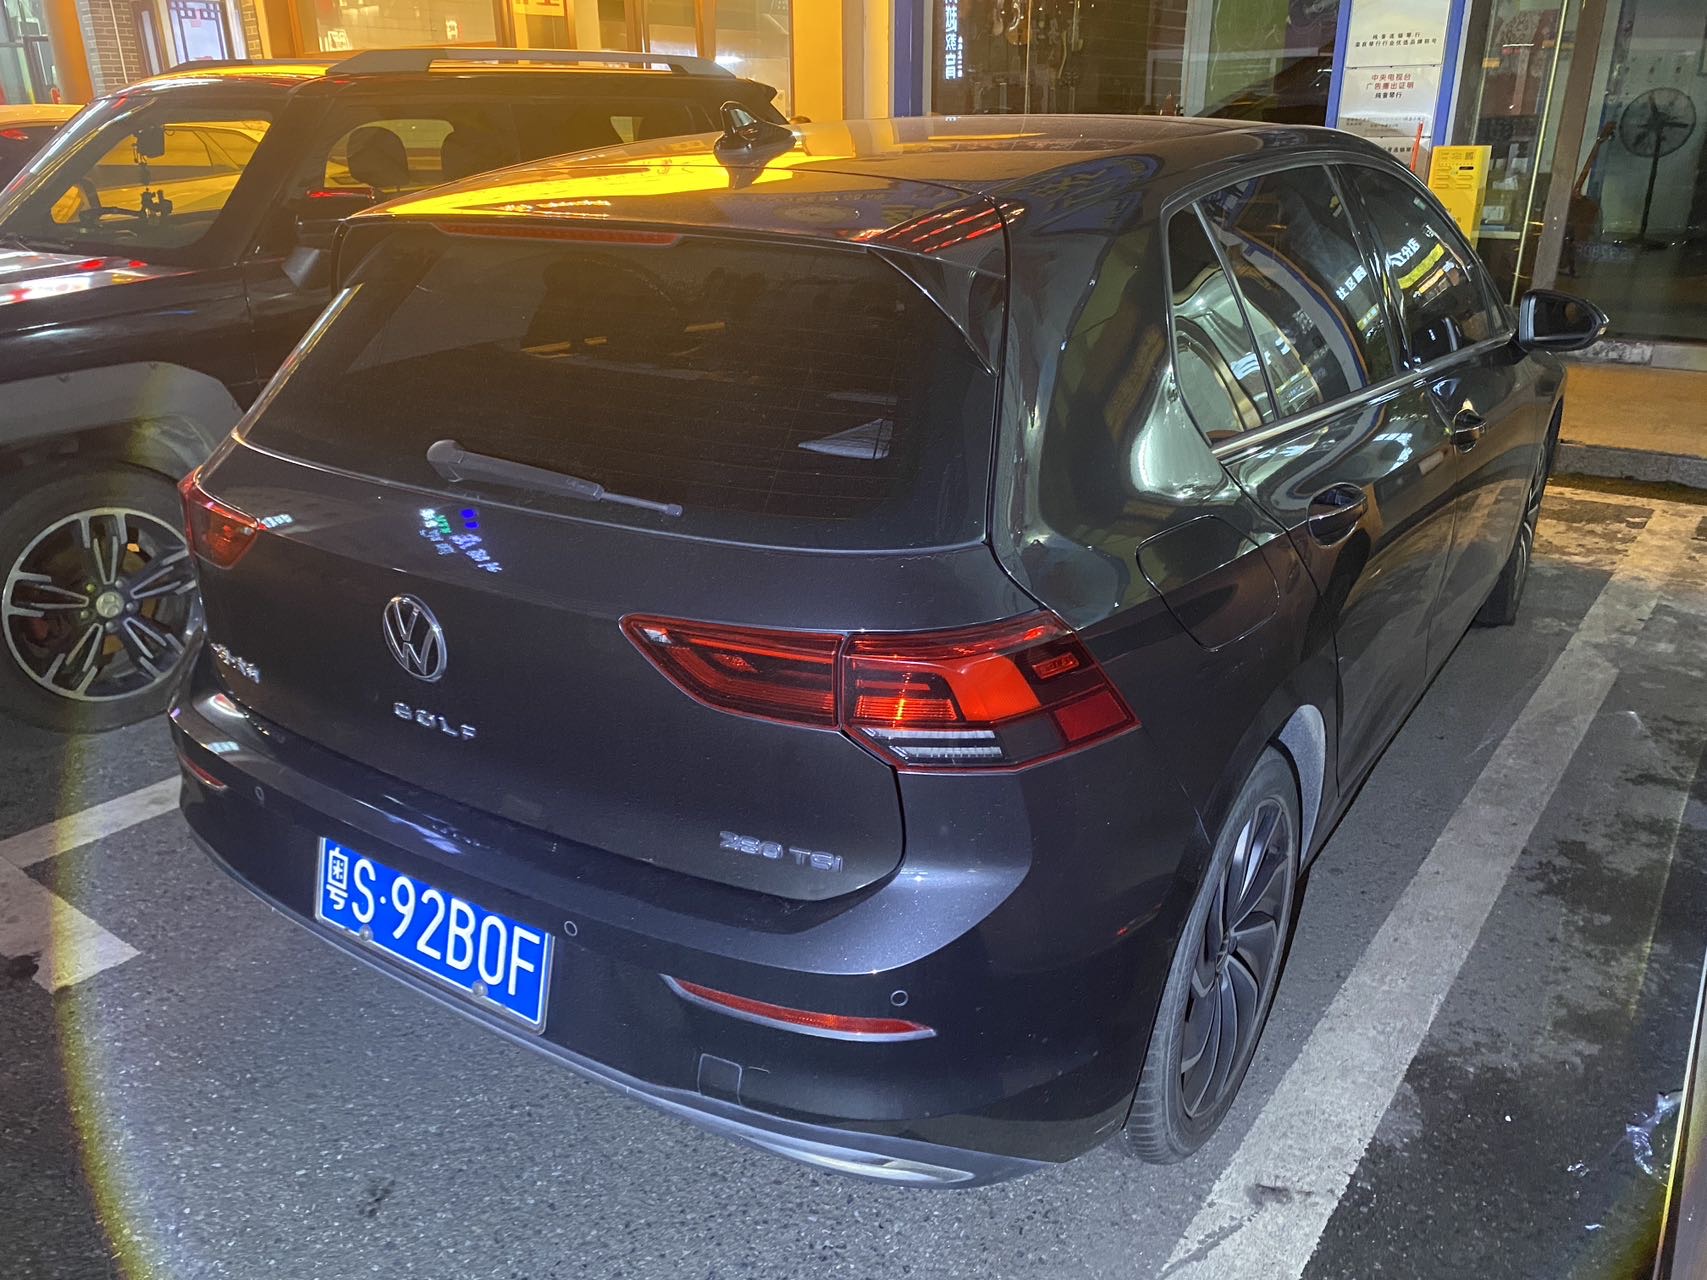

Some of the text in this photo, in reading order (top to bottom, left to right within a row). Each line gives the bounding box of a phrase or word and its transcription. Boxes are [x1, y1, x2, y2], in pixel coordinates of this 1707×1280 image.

[1366, 81, 1415, 90] 广告播出证明
[1371, 73, 1412, 82] 中央电视台
[393, 702, 478, 741] GOLF
[719, 830, 844, 873] 280 TSI
